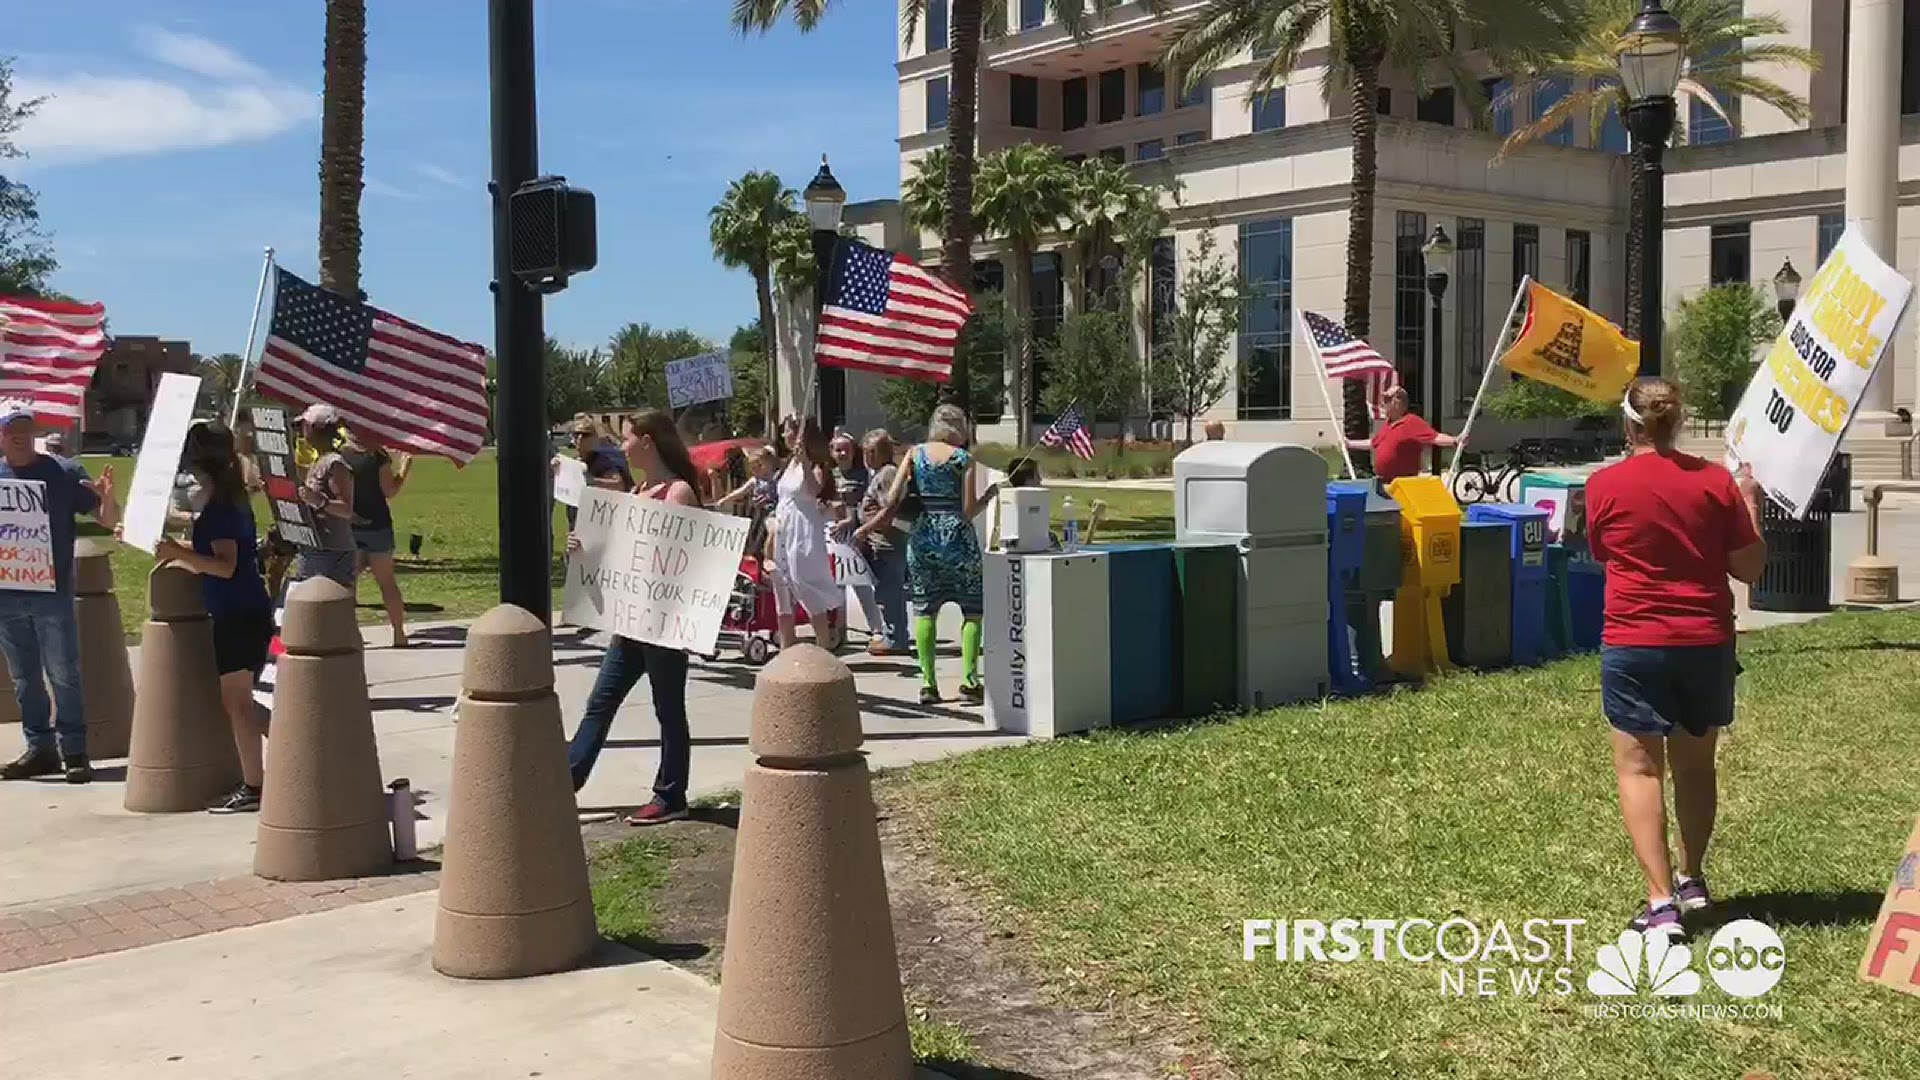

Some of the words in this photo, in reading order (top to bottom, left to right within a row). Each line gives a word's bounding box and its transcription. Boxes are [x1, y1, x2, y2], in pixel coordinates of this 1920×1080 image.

[1810, 345, 1837, 382] FOR
[1765, 388, 1795, 434] TOO
[590, 499, 618, 527] MY
[626, 505, 697, 543] RIGHTS
[631, 540, 690, 577] END
[580, 564, 640, 595] WHERE
[643, 576, 685, 604] YOUR
[1008, 558, 1024, 643] Record
[1010, 650, 1027, 710] Daily
[1868, 911, 1920, 986] F
